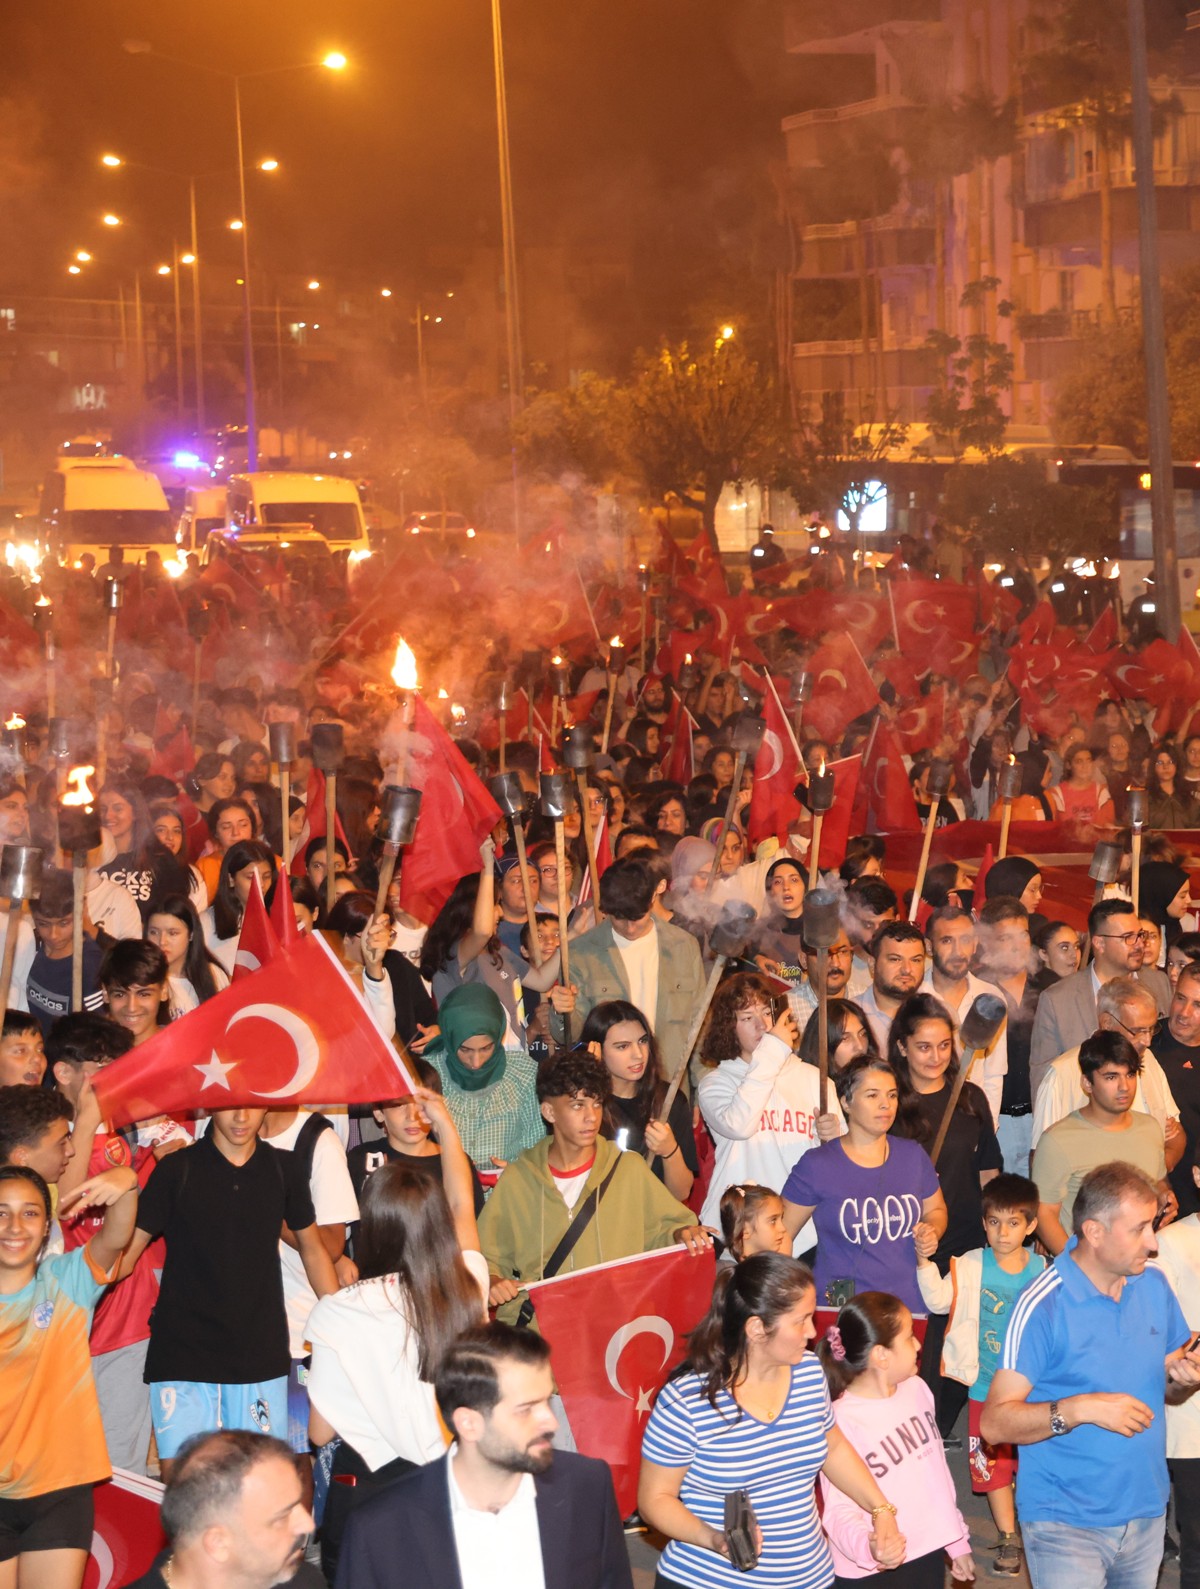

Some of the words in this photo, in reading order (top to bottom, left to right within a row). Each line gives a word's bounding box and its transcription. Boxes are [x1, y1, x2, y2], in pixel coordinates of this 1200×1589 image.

[29, 989, 63, 1011] adidas
[840, 1194, 921, 1244] GOOD
[160, 1387, 176, 1422] 9
